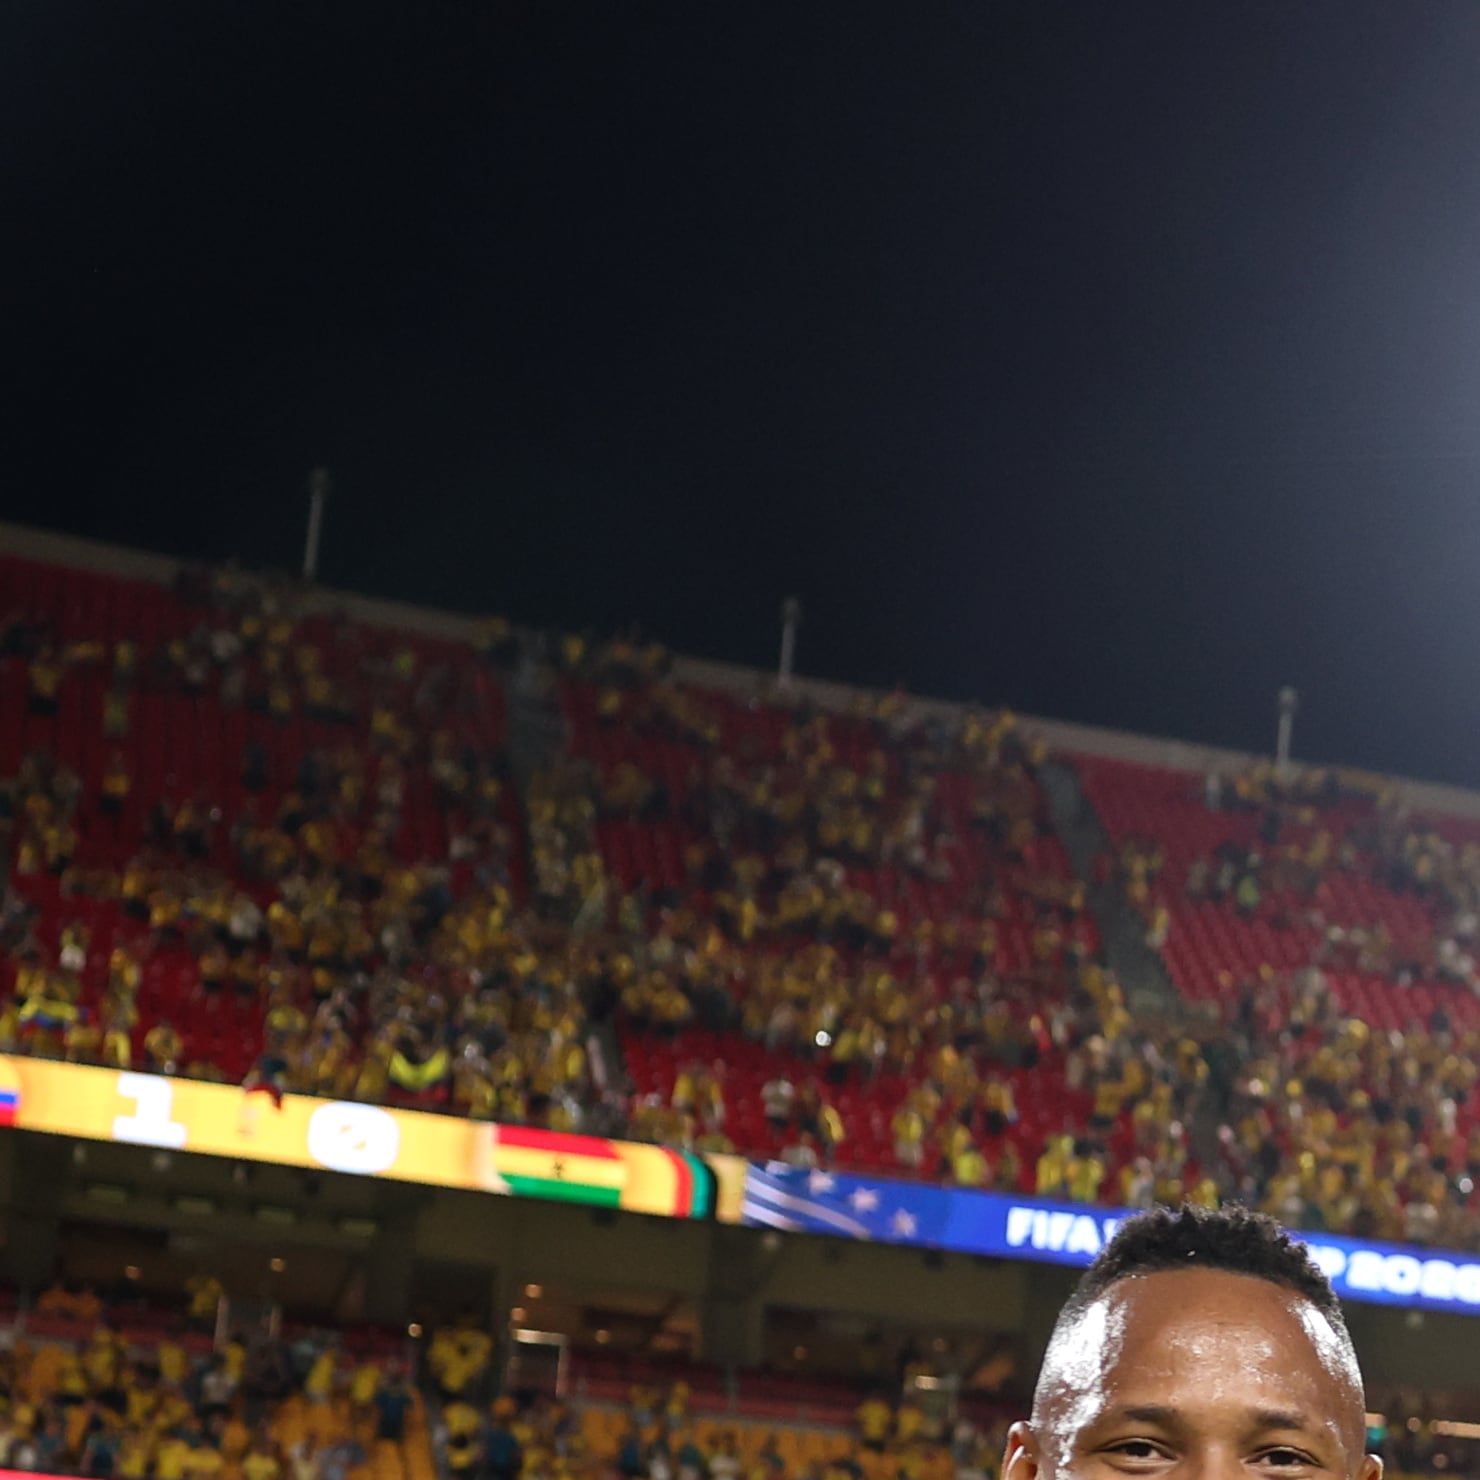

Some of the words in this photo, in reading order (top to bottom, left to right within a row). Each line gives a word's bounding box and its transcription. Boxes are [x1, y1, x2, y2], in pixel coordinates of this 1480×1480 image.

[111, 1072, 187, 1149] 1
[307, 1100, 399, 1175] 0
[1006, 1206, 1101, 1256] FIFA
